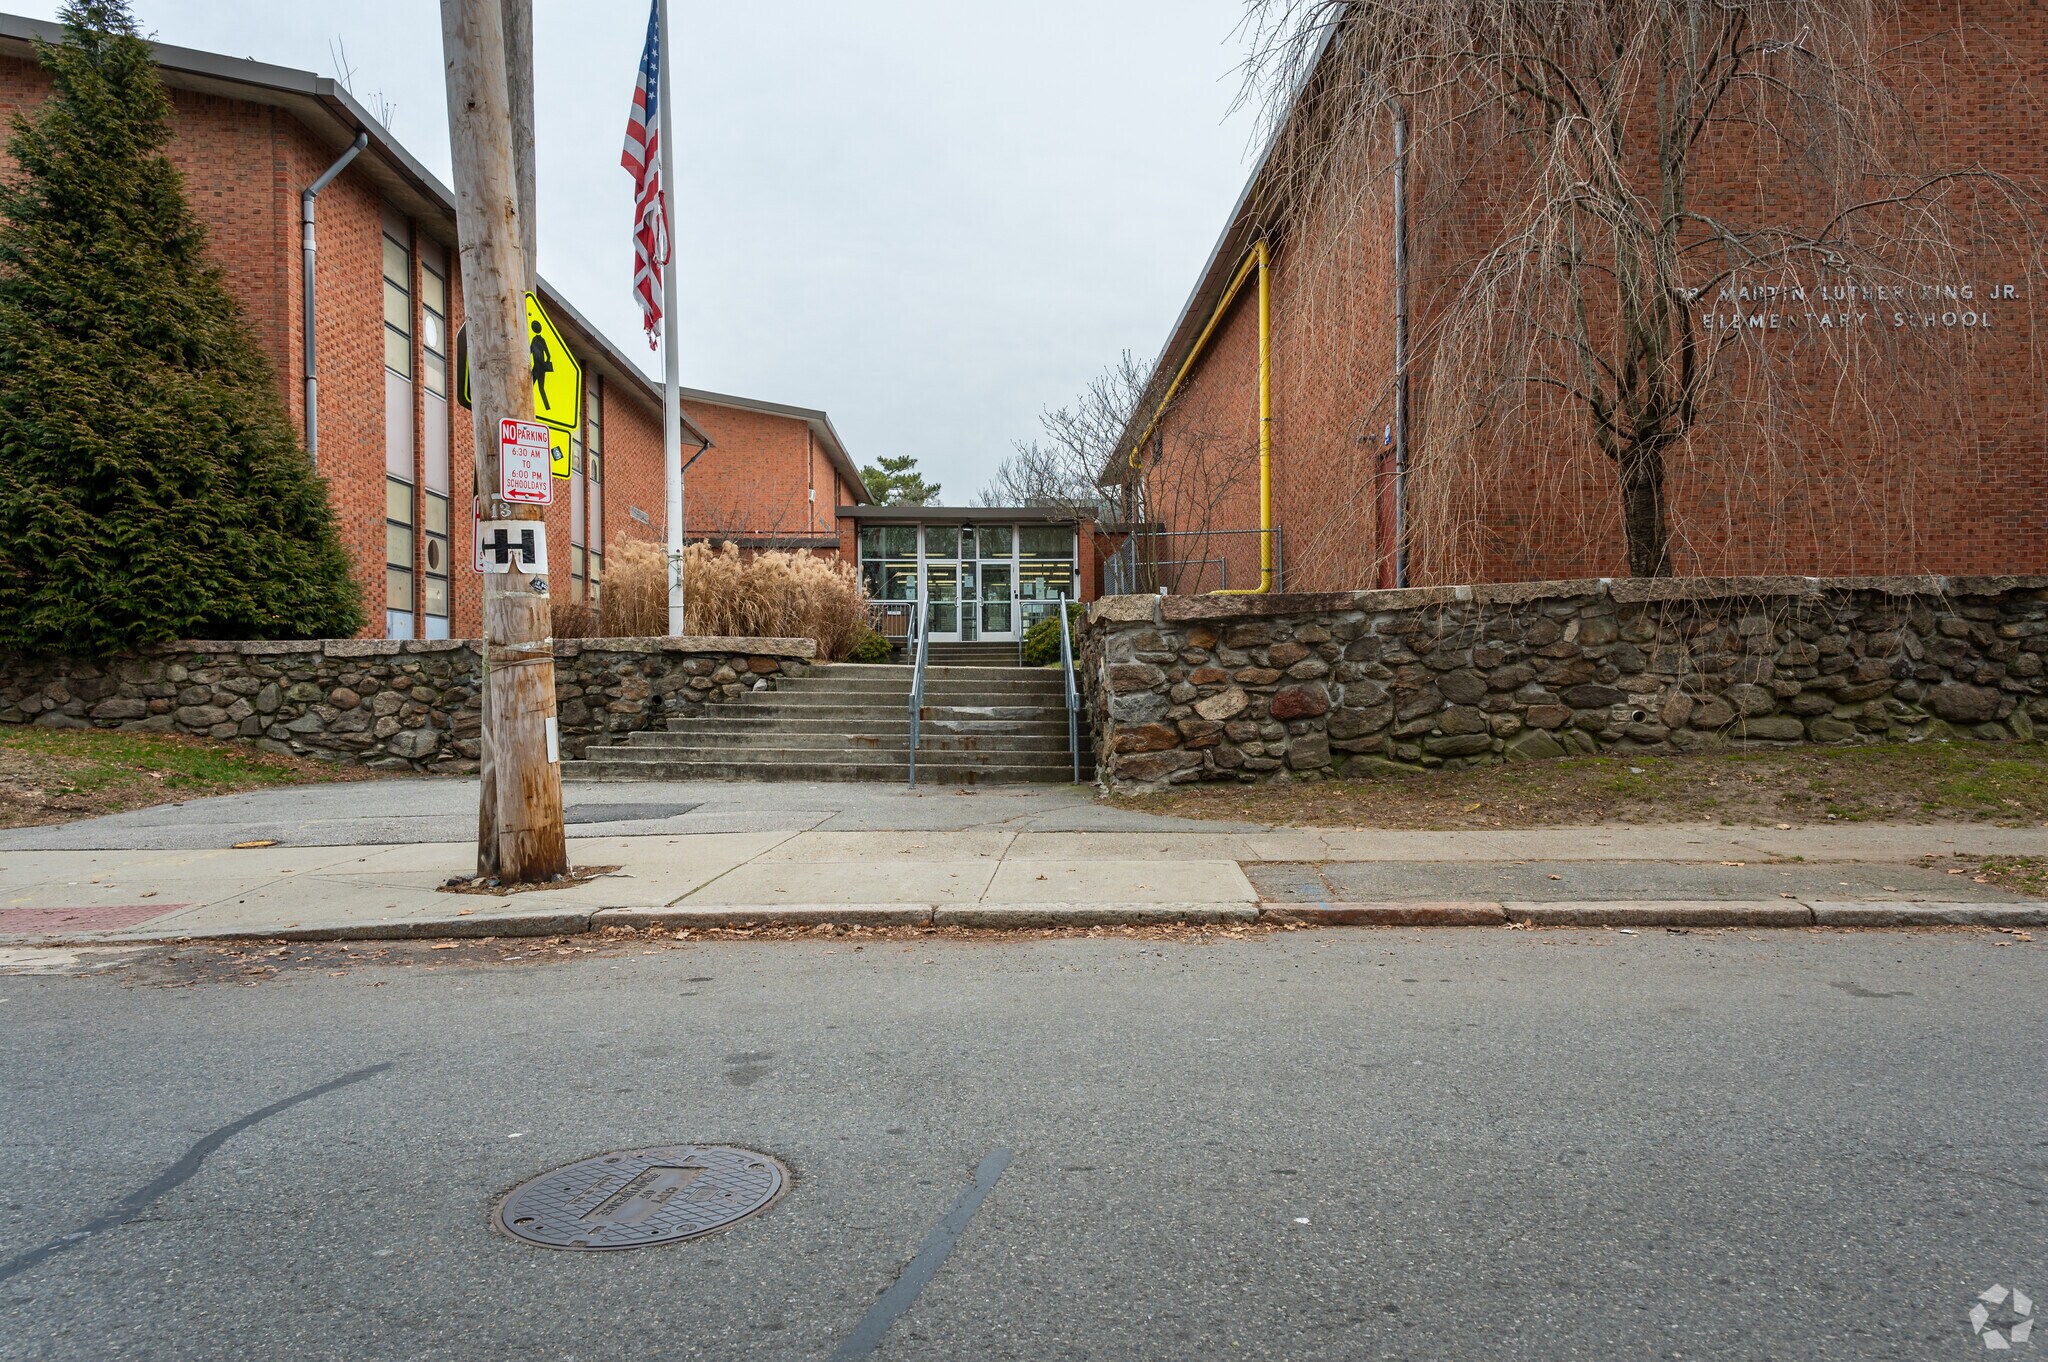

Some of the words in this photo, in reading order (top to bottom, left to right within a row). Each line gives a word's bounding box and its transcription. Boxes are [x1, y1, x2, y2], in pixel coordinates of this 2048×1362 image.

[1720, 286, 1805, 301] MARTIN
[1822, 285, 1904, 301] LUTHER
[1989, 284, 2020, 300] JR.
[1702, 312, 1867, 329] ELEMENTARY
[502, 423, 516, 440] NO
[517, 428, 548, 443] PARKING
[511, 447, 528, 457] 6:30
[530, 450, 541, 459] AM
[522, 459, 531, 469] TO
[511, 469, 529, 479] 6:00
[531, 471, 543, 481] PM
[506, 478, 547, 491] SCHOOLDAYS
[491, 502, 512, 518] 13
[595, 1172, 661, 1216] PROVIDENCE
[639, 1189, 656, 1200] OF
[651, 1186, 679, 1204] CITY
